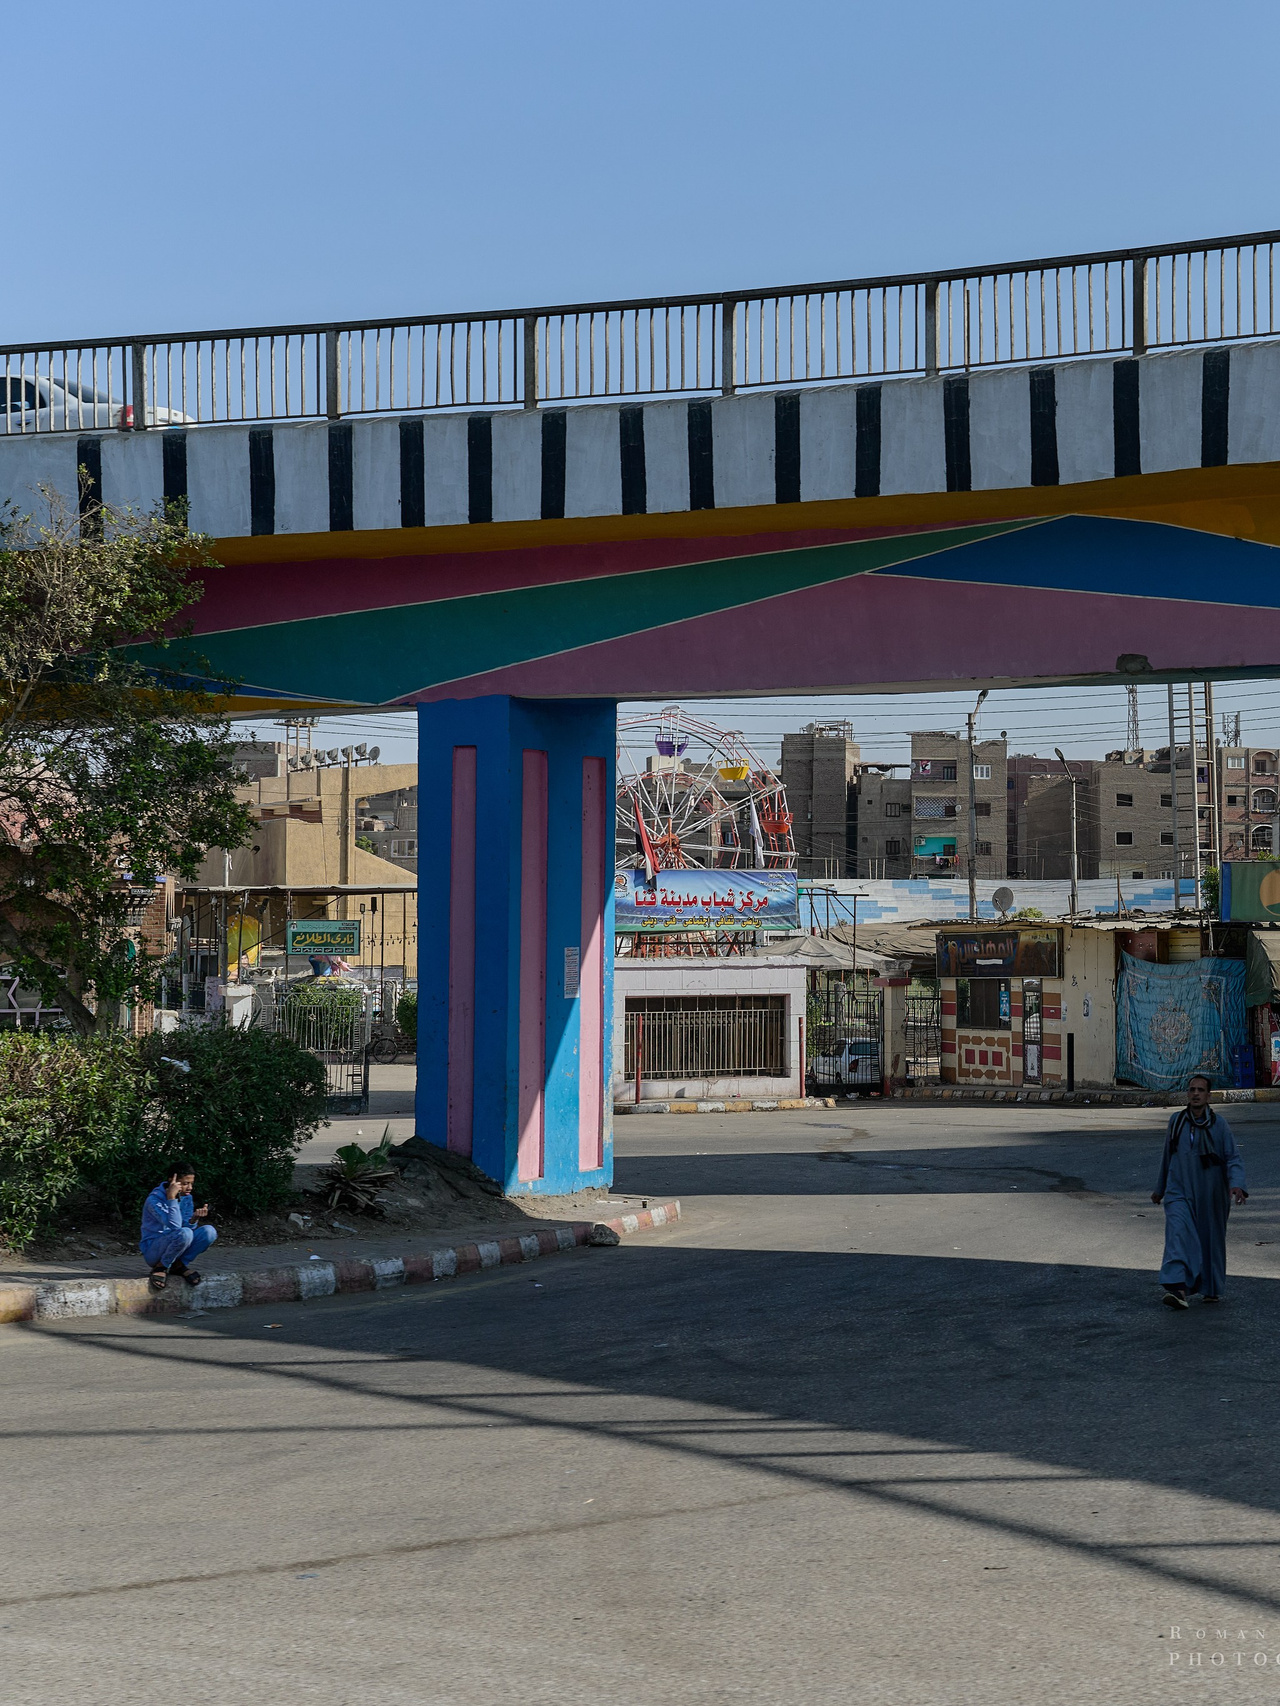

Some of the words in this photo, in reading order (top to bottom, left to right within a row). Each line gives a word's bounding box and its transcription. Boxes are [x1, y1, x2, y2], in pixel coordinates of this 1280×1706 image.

[634, 888, 657, 908] قنا
[660, 888, 698, 914] مدينة
[701, 888, 735, 913] شباب
[738, 890, 769, 913] مركز
[330, 933, 354, 945] نادى
